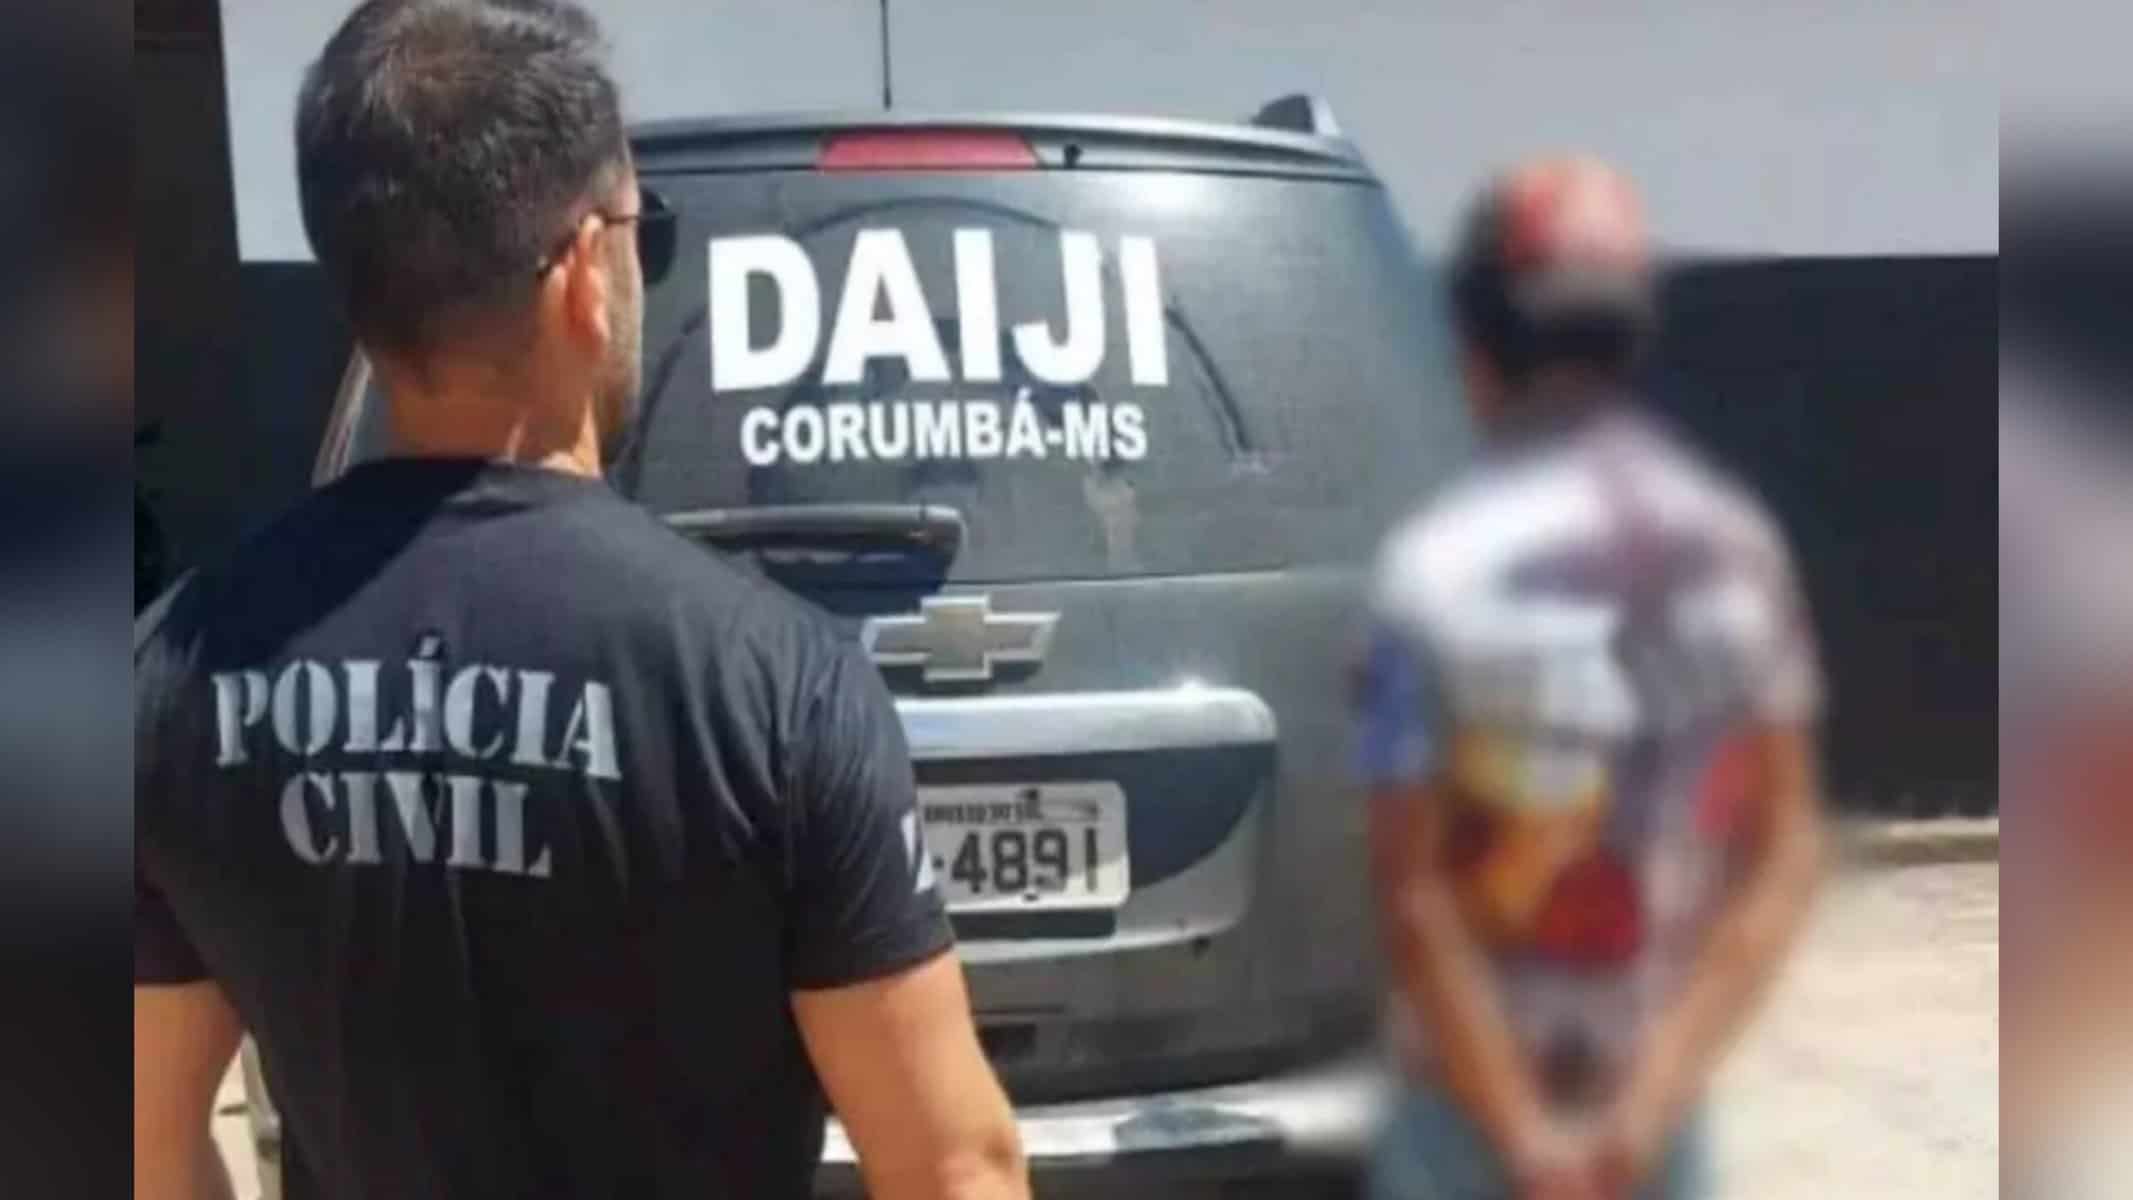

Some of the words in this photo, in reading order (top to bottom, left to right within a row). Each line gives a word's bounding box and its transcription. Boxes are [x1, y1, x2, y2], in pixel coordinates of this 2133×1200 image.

[709, 228, 1169, 390] DAIJI
[740, 388, 1148, 465] CORUMBÁ-MS
[211, 636, 621, 780] POLÍCIA
[279, 769, 552, 878] CIVIL
